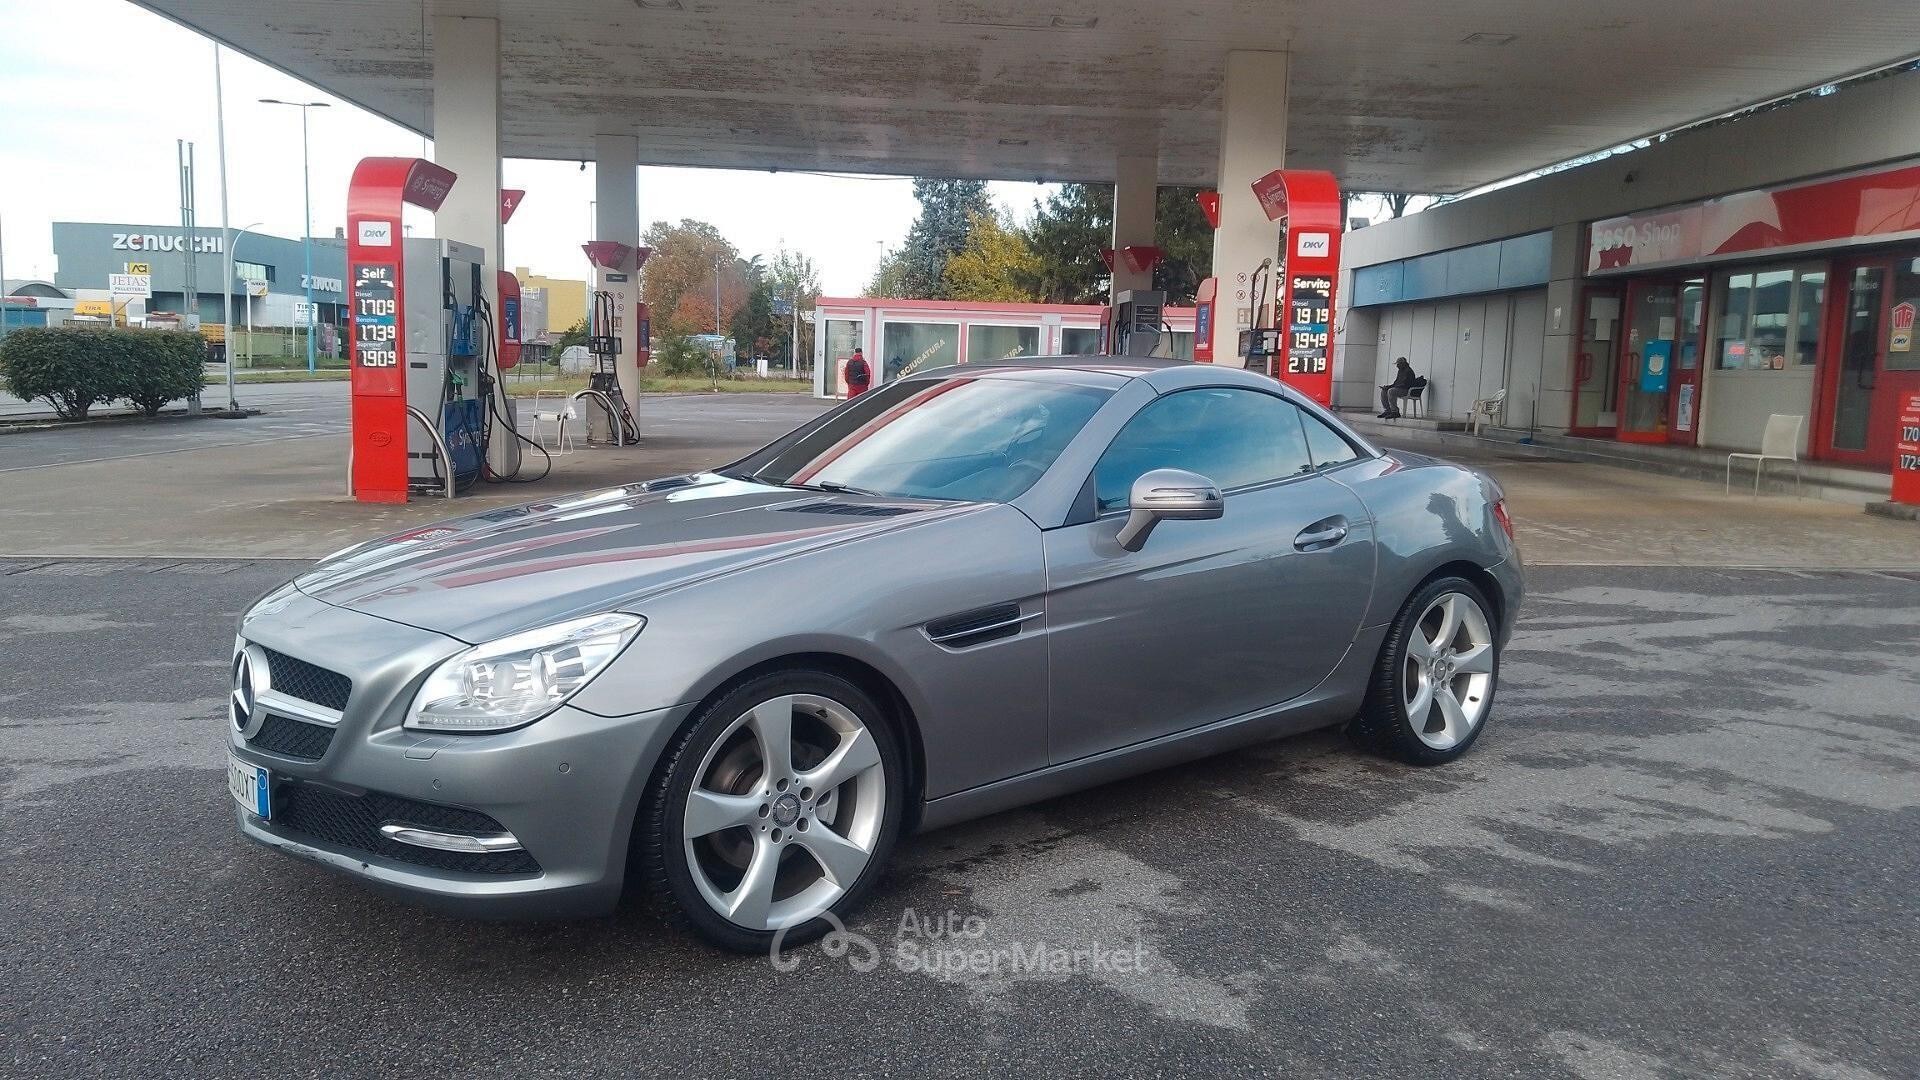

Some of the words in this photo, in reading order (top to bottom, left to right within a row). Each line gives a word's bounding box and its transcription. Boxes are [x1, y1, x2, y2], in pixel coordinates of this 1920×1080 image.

[503, 198, 513, 209] 4
[1210, 201, 1216, 213] 1
[363, 229, 387, 238] DKV
[1303, 241, 1324, 249] DKV
[361, 267, 386, 279] Self
[112, 276, 148, 286] JETAS
[1293, 278, 1331, 289] Servito
[896, 339, 946, 380] ASCIUGATURA
